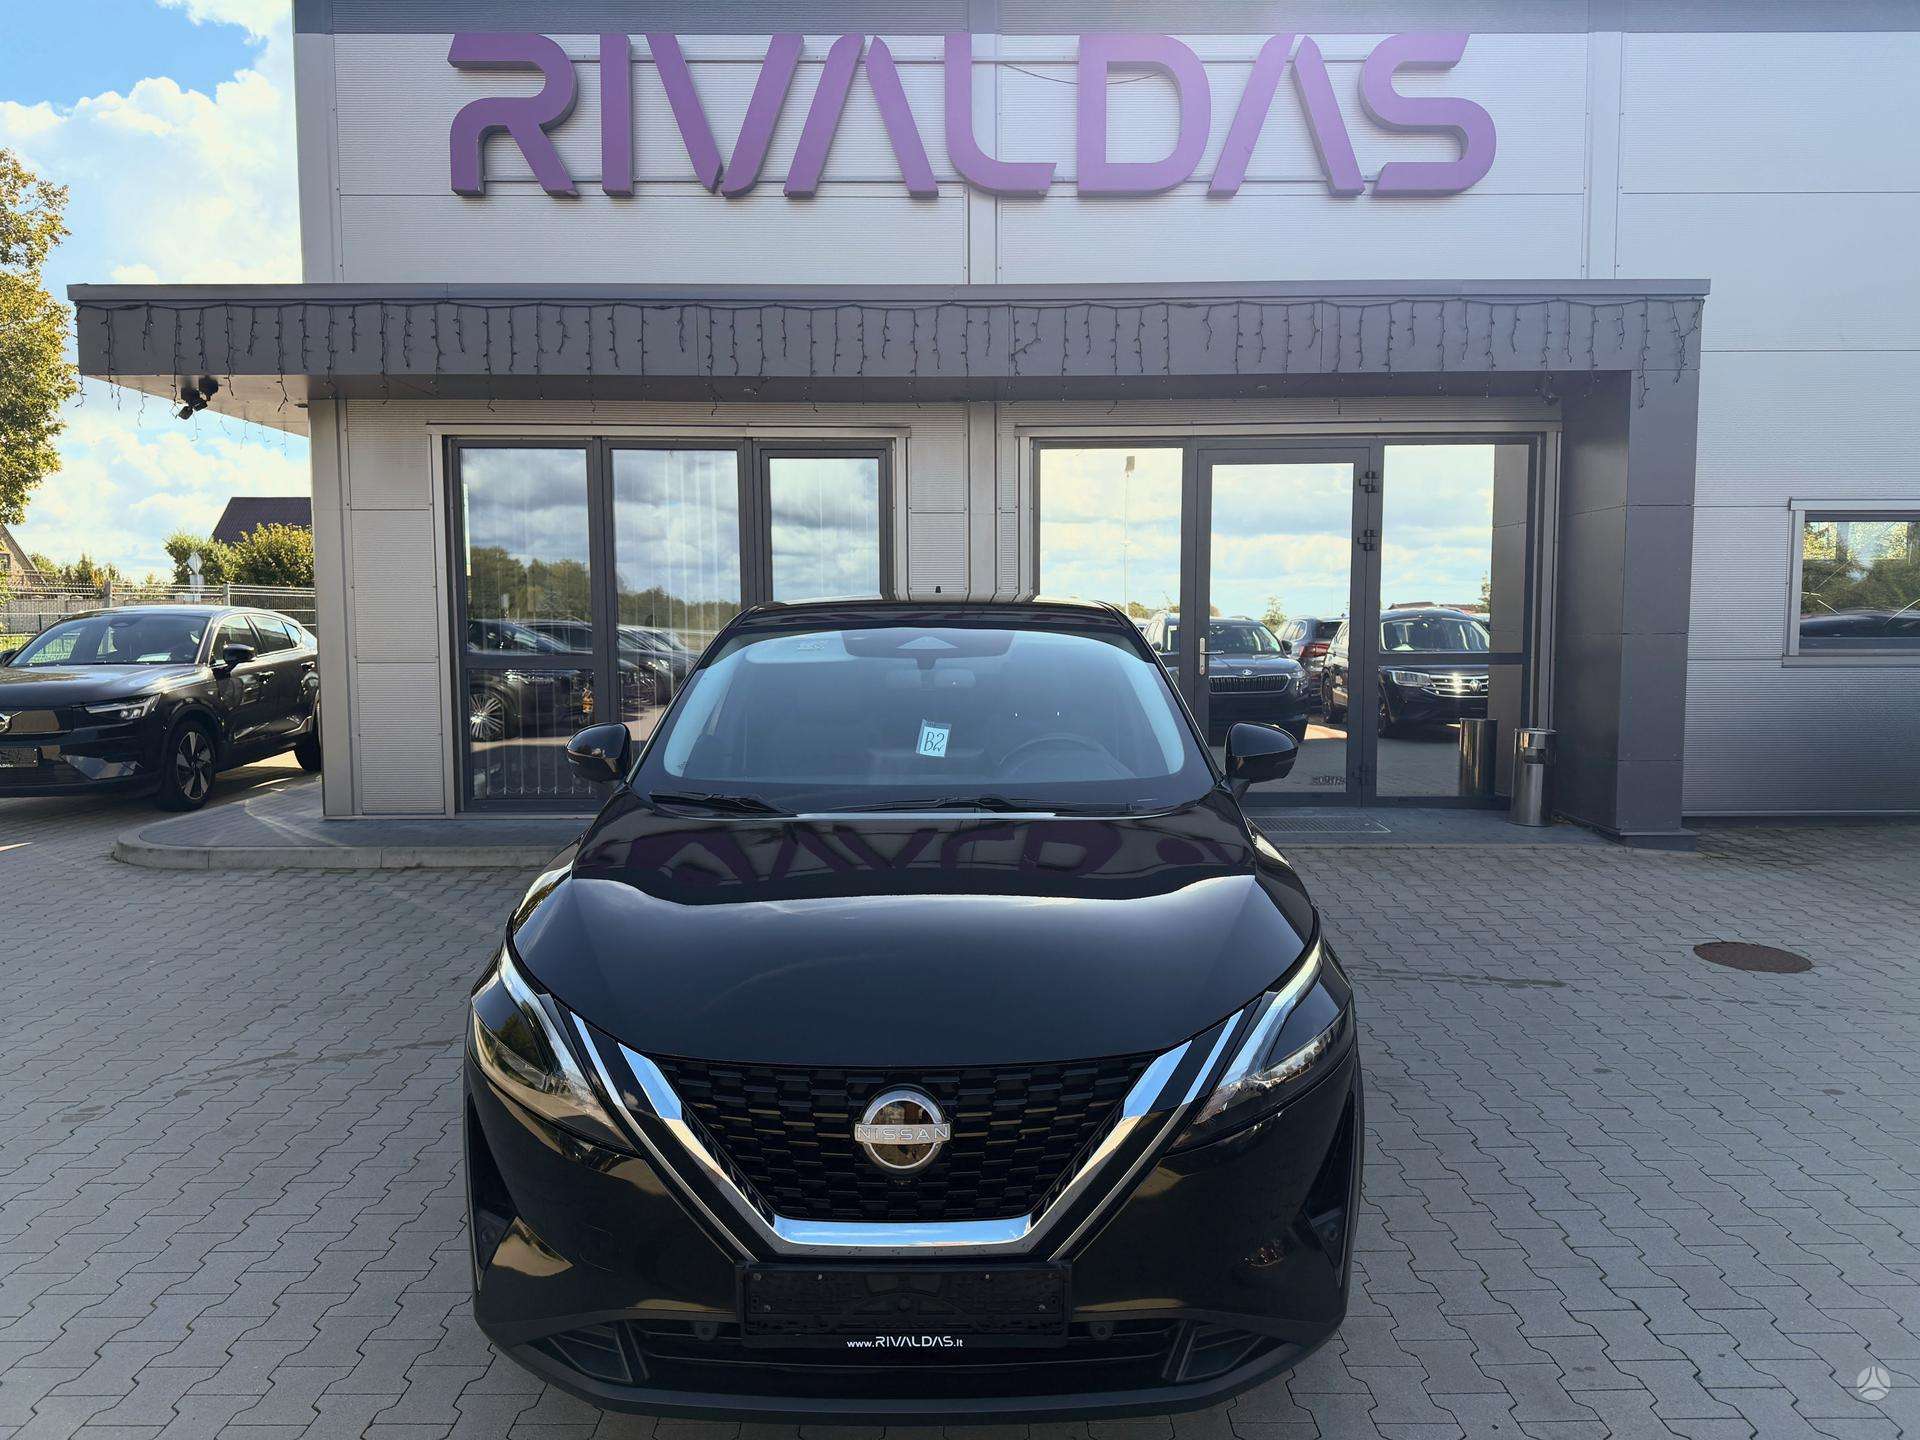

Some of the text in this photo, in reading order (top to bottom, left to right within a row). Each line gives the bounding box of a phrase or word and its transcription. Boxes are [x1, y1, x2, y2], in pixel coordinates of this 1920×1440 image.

[448, 33, 1497, 199] RIVALDAS
[923, 731, 945, 752] B2
[856, 1126, 949, 1141] NISSAN
[846, 1335, 963, 1348] www.RIVALDAS.lt
